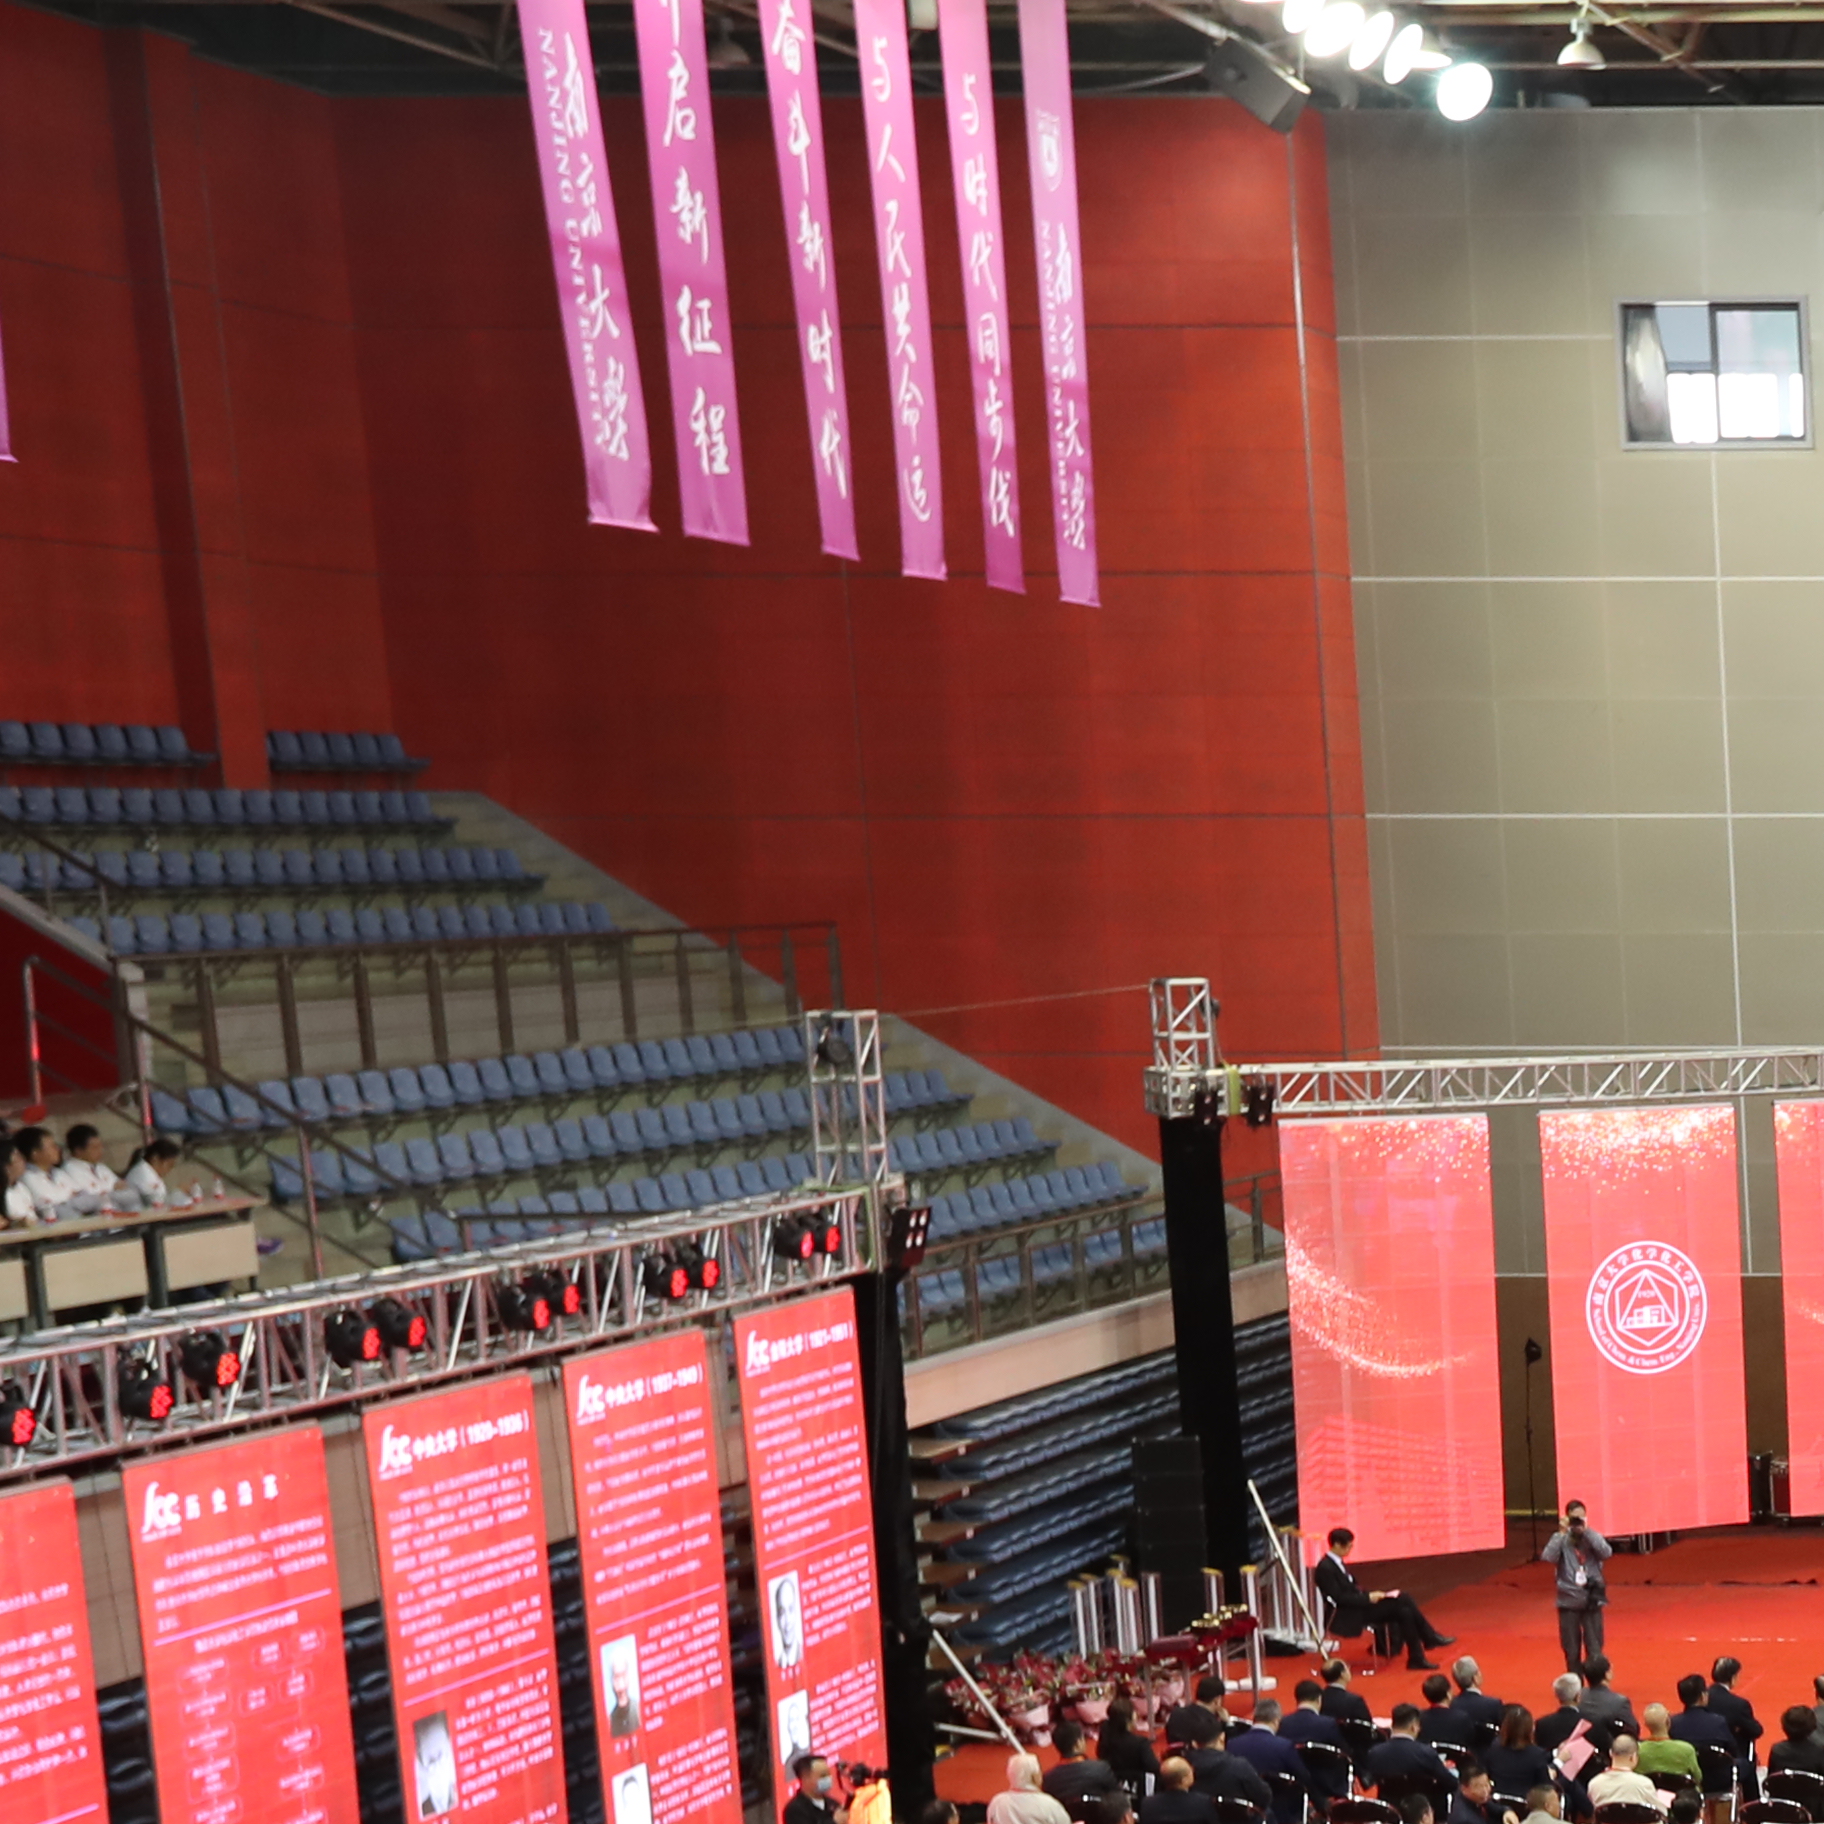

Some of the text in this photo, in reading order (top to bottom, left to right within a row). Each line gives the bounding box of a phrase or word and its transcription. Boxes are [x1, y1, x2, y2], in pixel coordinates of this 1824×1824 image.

[661, 0, 730, 475] 启新征程
[870, 35, 931, 522] 与人民共命运
[960, 72, 1015, 538] 与时代同步伐
